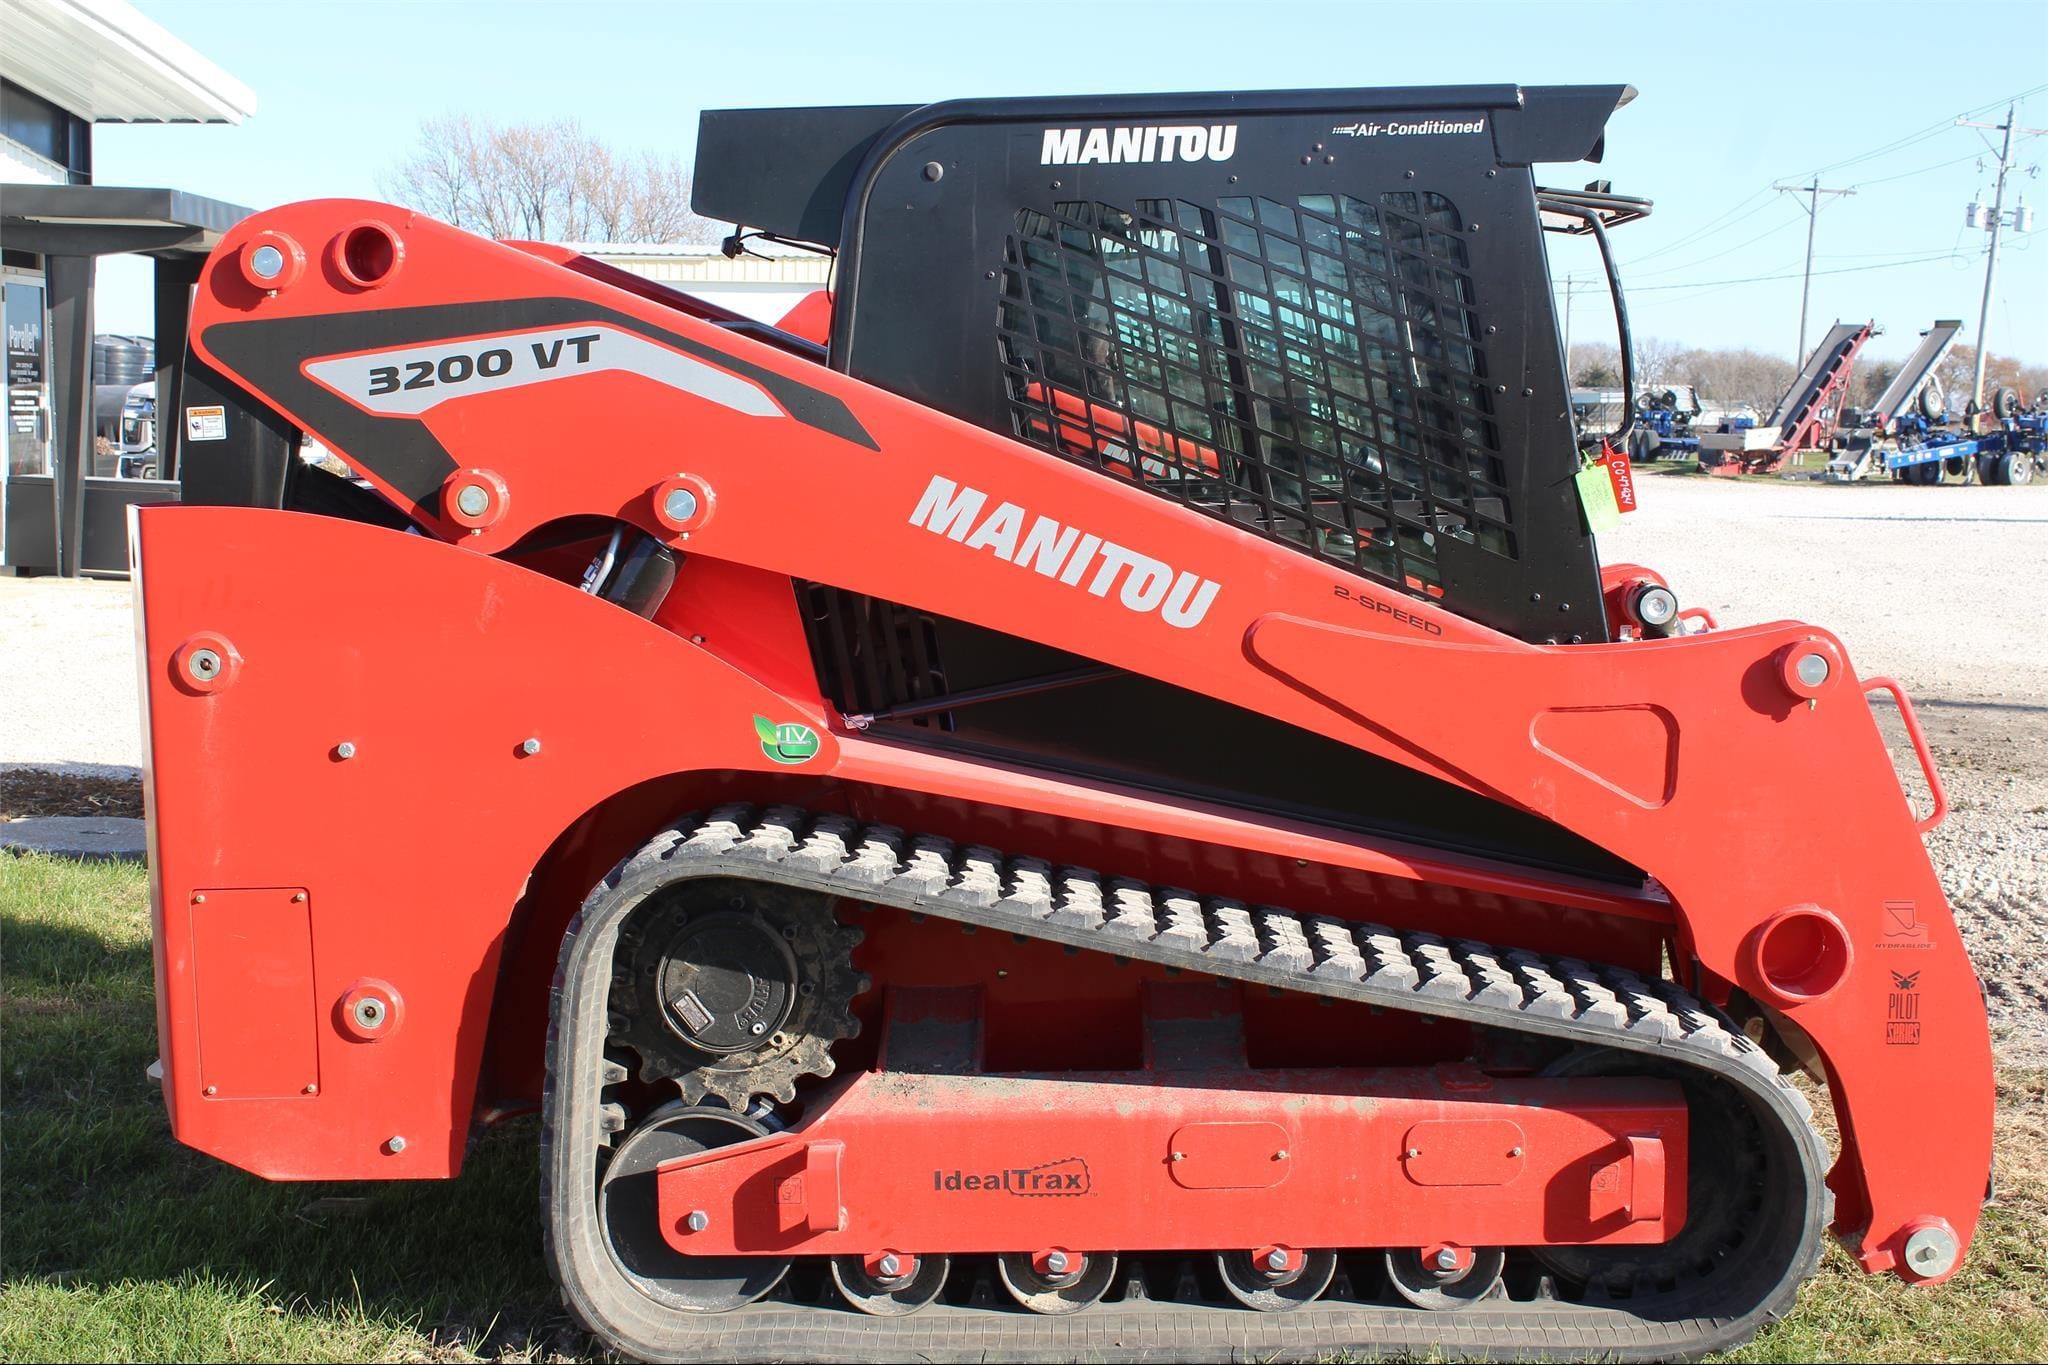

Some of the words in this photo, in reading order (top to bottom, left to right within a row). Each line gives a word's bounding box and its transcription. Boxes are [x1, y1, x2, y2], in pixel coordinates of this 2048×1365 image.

[1040, 124, 1238, 166] MANITOU
[1356, 118, 1485, 137] Air-Conditioned
[368, 348, 513, 396] 3200
[531, 333, 601, 370] VT
[908, 473, 1222, 629] MANITOU
[1333, 584, 1442, 636] 2-SPEED
[1888, 993, 1921, 1020] PILOT
[933, 1169, 1083, 1191] IdealTrax
